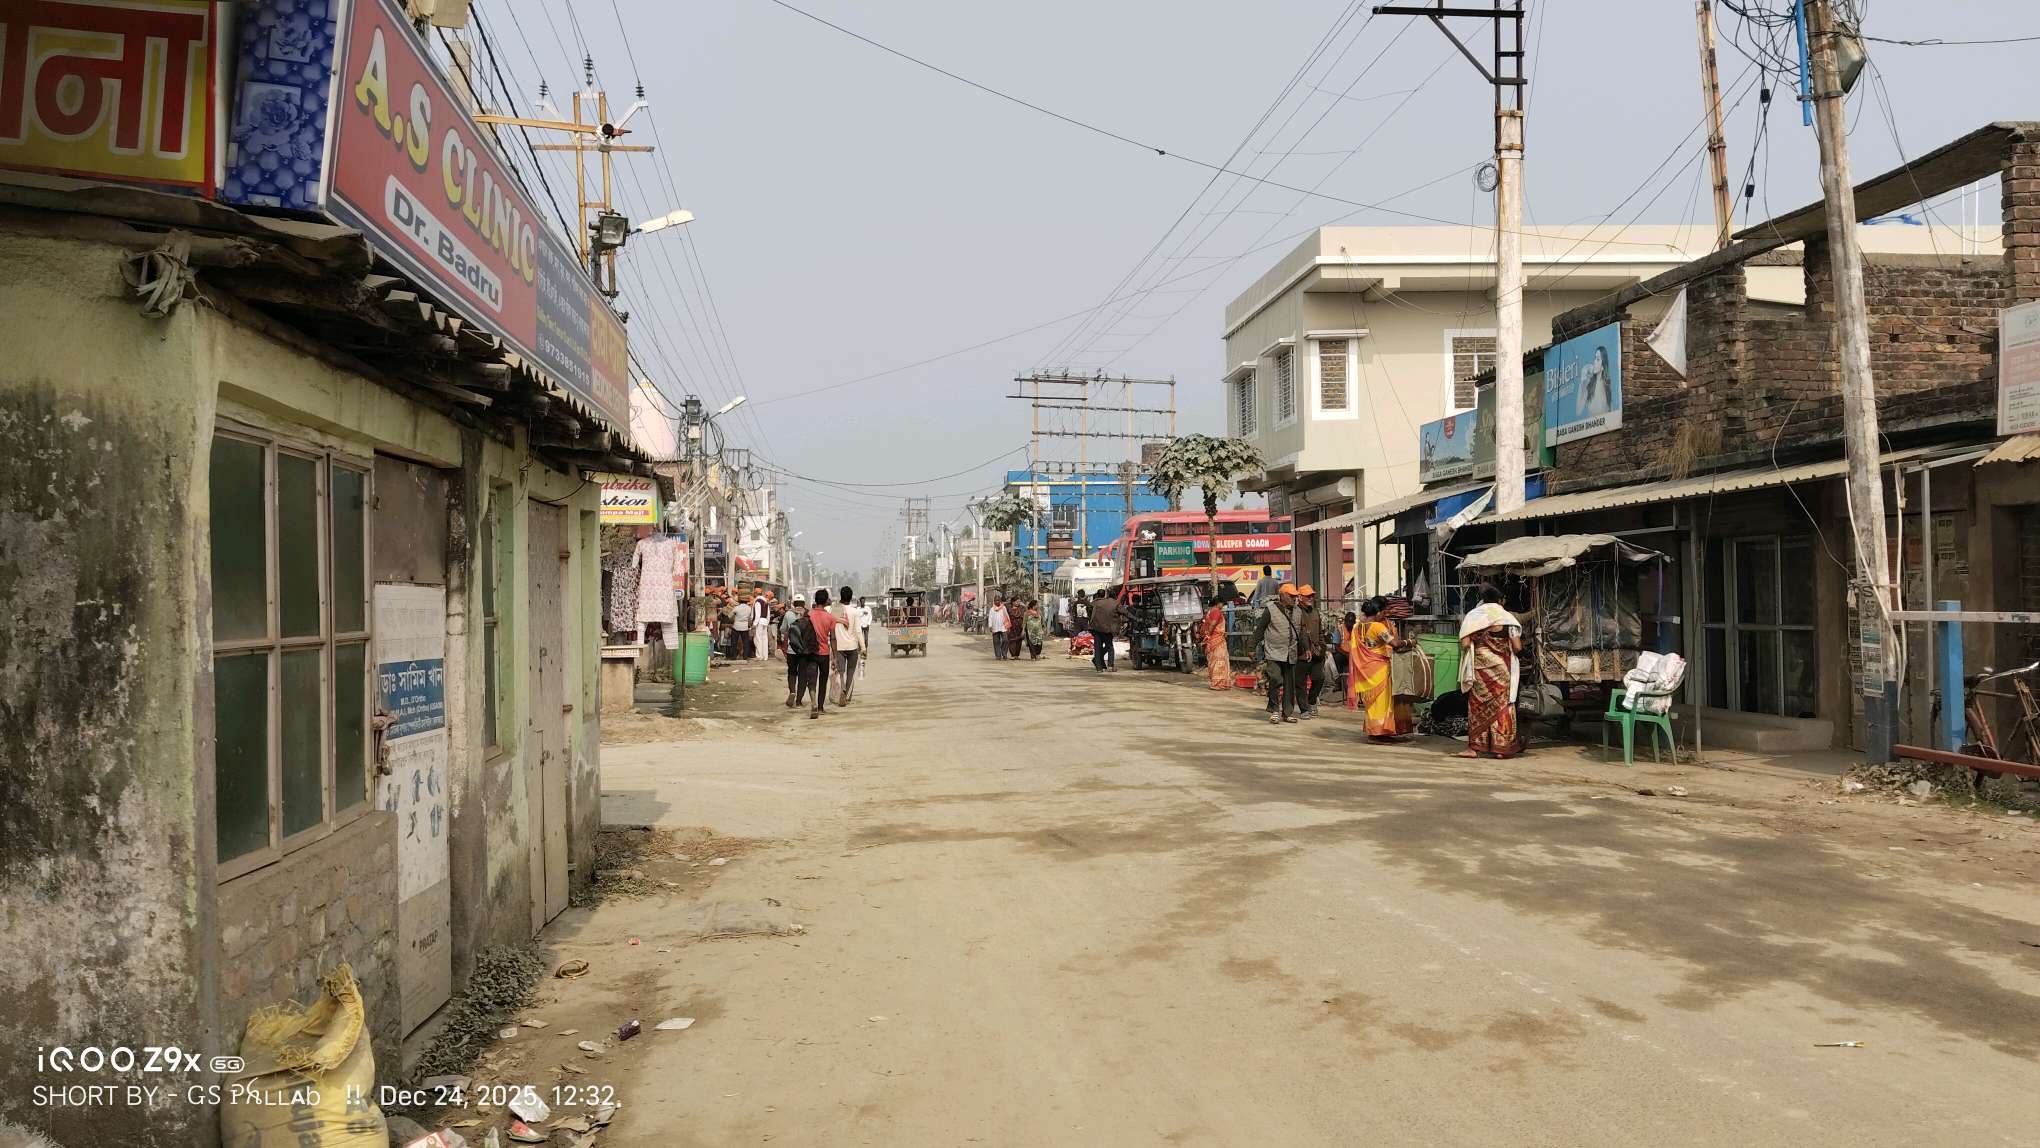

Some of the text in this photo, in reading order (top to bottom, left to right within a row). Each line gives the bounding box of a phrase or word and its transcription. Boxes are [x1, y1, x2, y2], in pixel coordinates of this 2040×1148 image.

[355, 27, 535, 284] A.S CLINIC
[393, 190, 430, 246] Dr.
[437, 230, 499, 306] Badru
[1158, 545, 1191, 556] PARKING
[1216, 539, 1243, 549] SLEEPER
[1245, 538, 1270, 548] COACH
